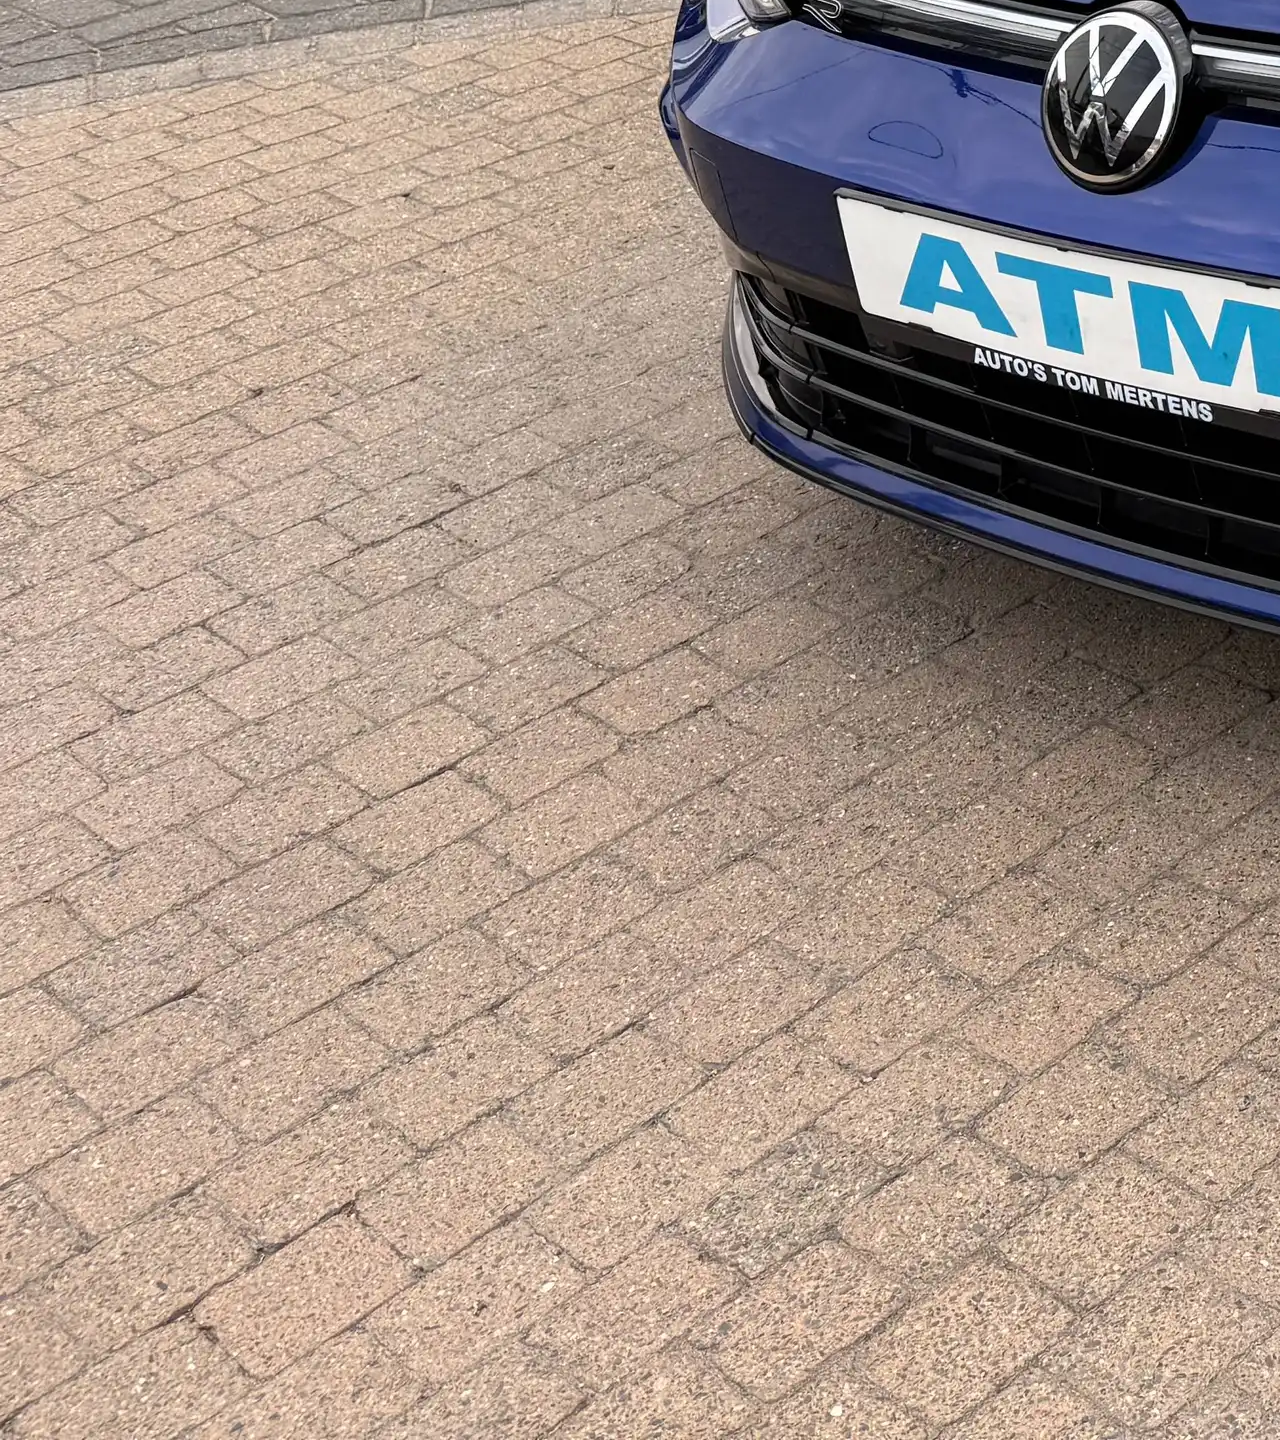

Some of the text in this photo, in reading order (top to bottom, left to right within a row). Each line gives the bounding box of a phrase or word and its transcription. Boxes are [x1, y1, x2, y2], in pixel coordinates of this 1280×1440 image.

[974, 347, 1214, 423] AUTO'S TOM MERTENS
